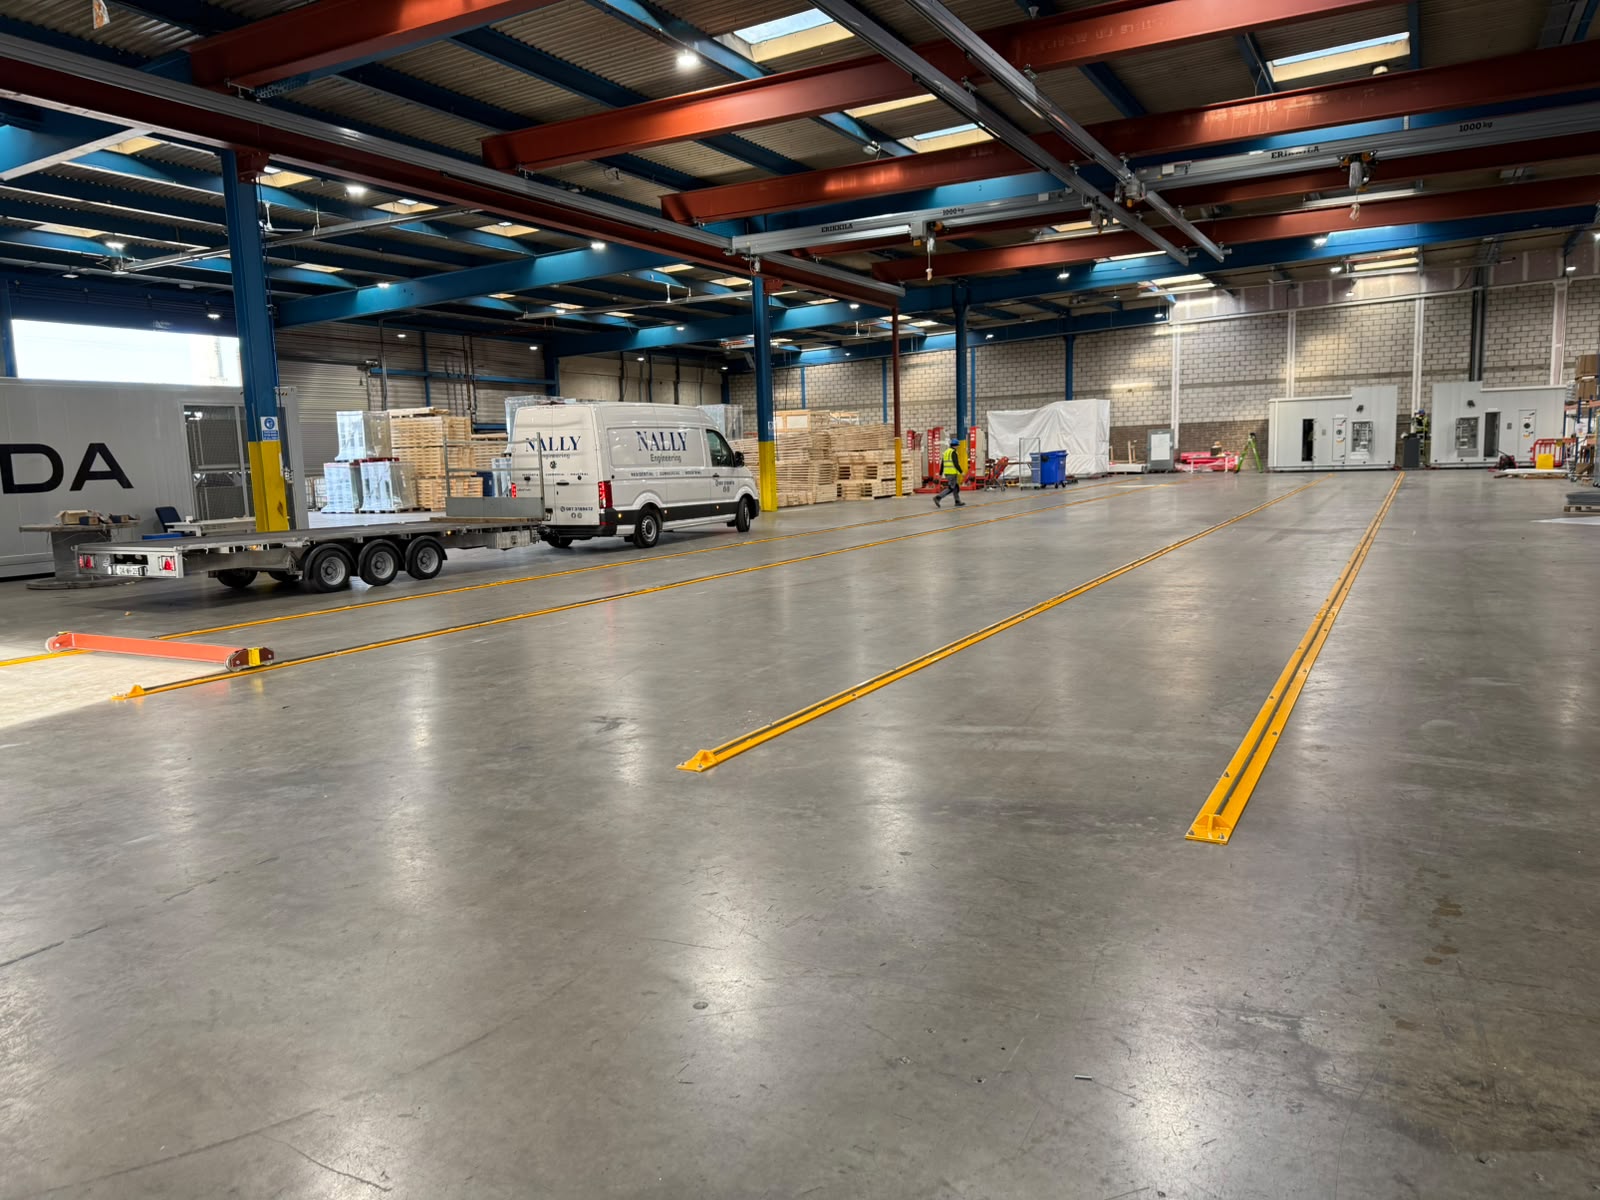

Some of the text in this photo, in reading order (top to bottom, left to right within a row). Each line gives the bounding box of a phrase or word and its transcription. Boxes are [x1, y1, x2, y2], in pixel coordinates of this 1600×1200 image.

[1459, 122, 1482, 132] 1000
[525, 436, 581, 452] NALLY
[636, 431, 688, 451] NALLY
[650, 453, 682, 464] Engineering
[0, 442, 135, 494] DA
